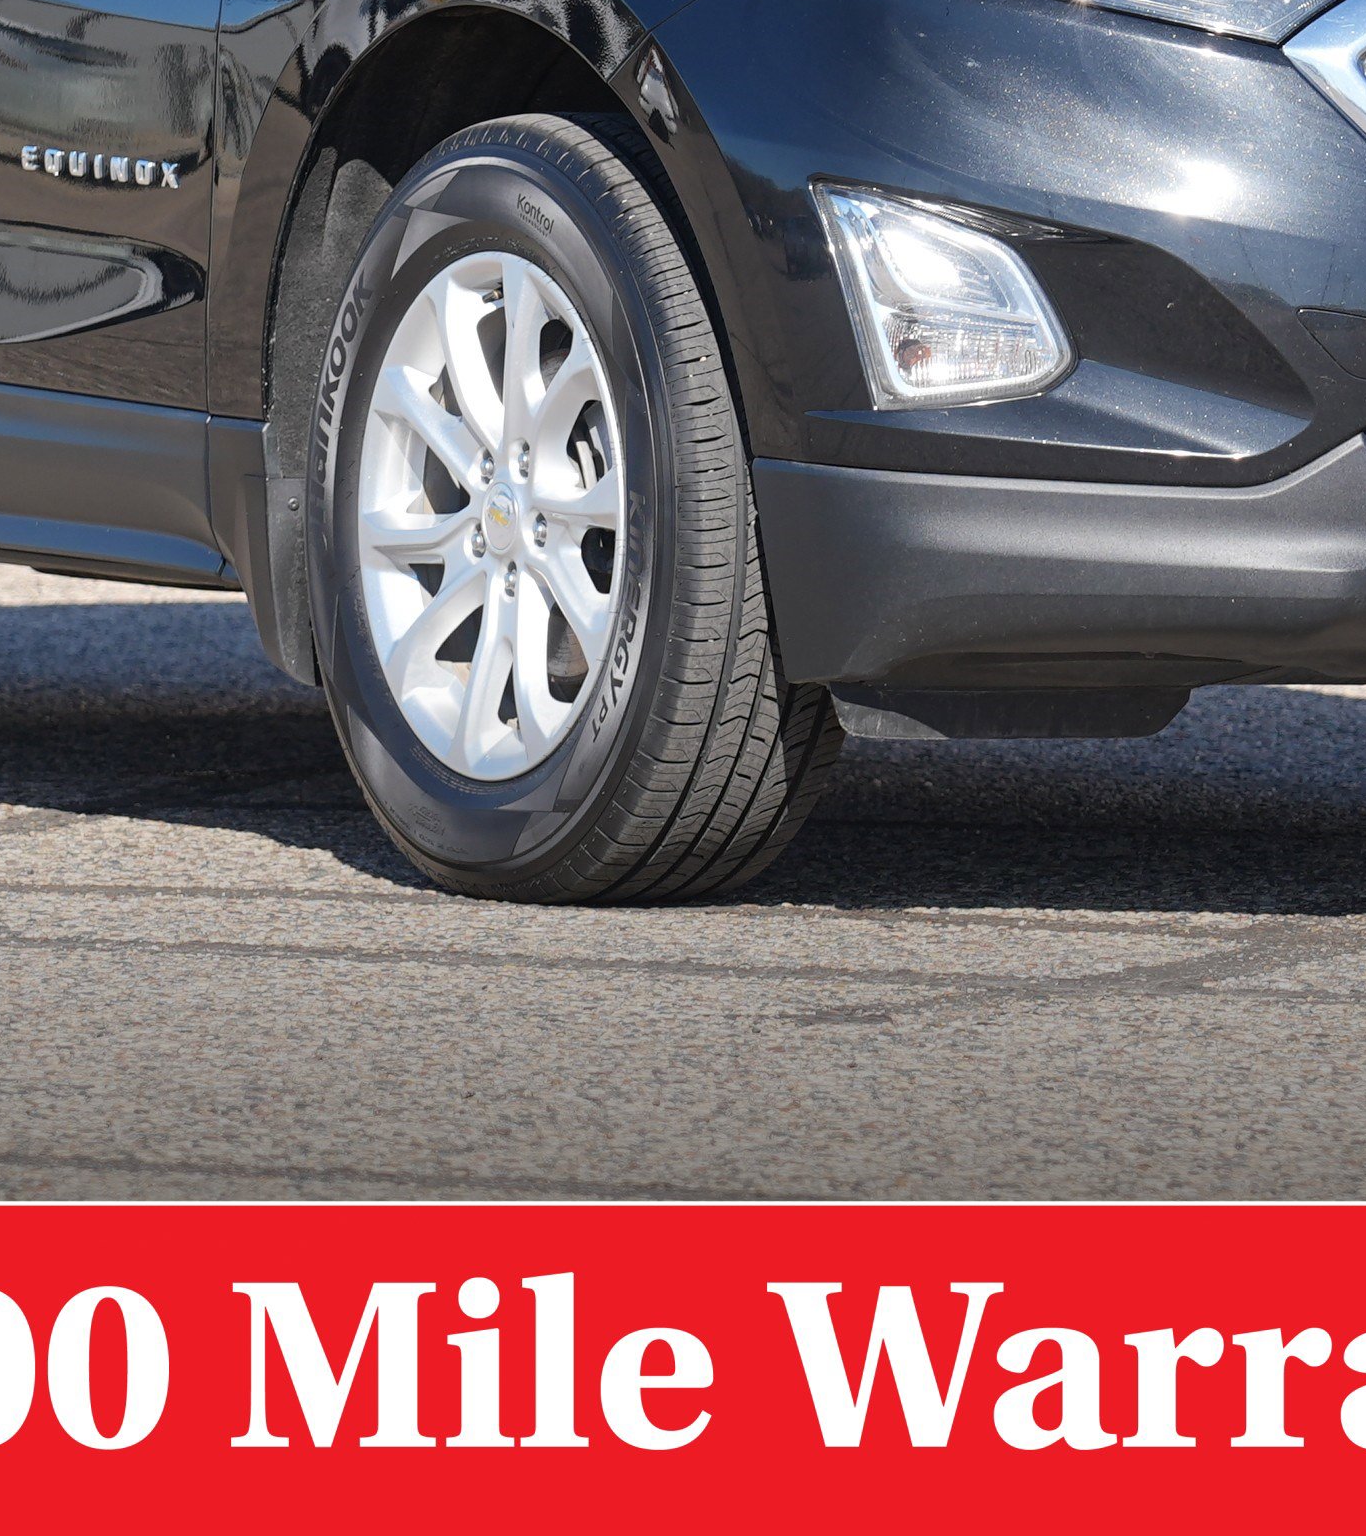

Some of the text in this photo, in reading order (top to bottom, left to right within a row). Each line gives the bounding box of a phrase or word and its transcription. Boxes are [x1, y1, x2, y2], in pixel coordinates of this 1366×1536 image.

[21, 145, 179, 189] EQUINOX
[516, 193, 554, 234] Kontrol
[591, 695, 610, 743] PT
